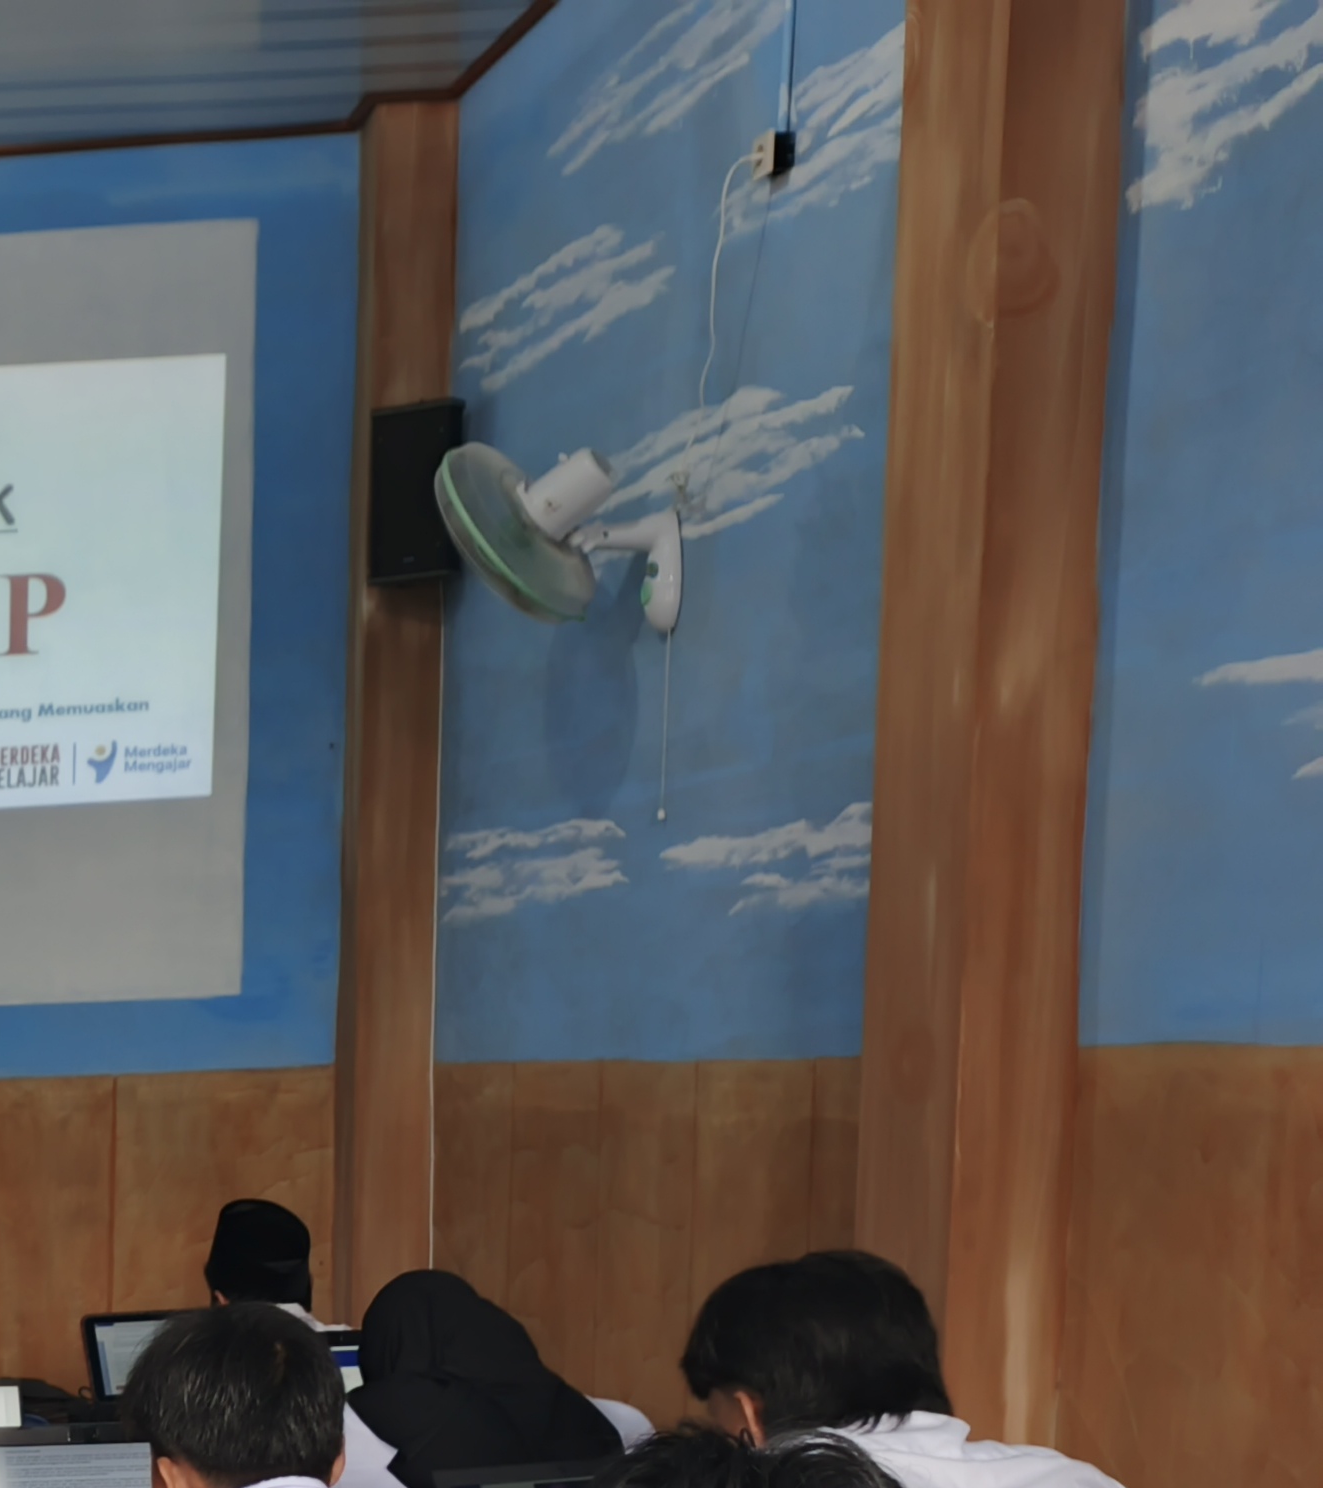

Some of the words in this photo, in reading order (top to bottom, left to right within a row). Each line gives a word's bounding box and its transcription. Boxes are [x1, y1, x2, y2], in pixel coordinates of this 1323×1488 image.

[37, 698, 150, 718] Memuaskan
[123, 743, 188, 758] Merdeka
[123, 756, 192, 775] Mengajar
